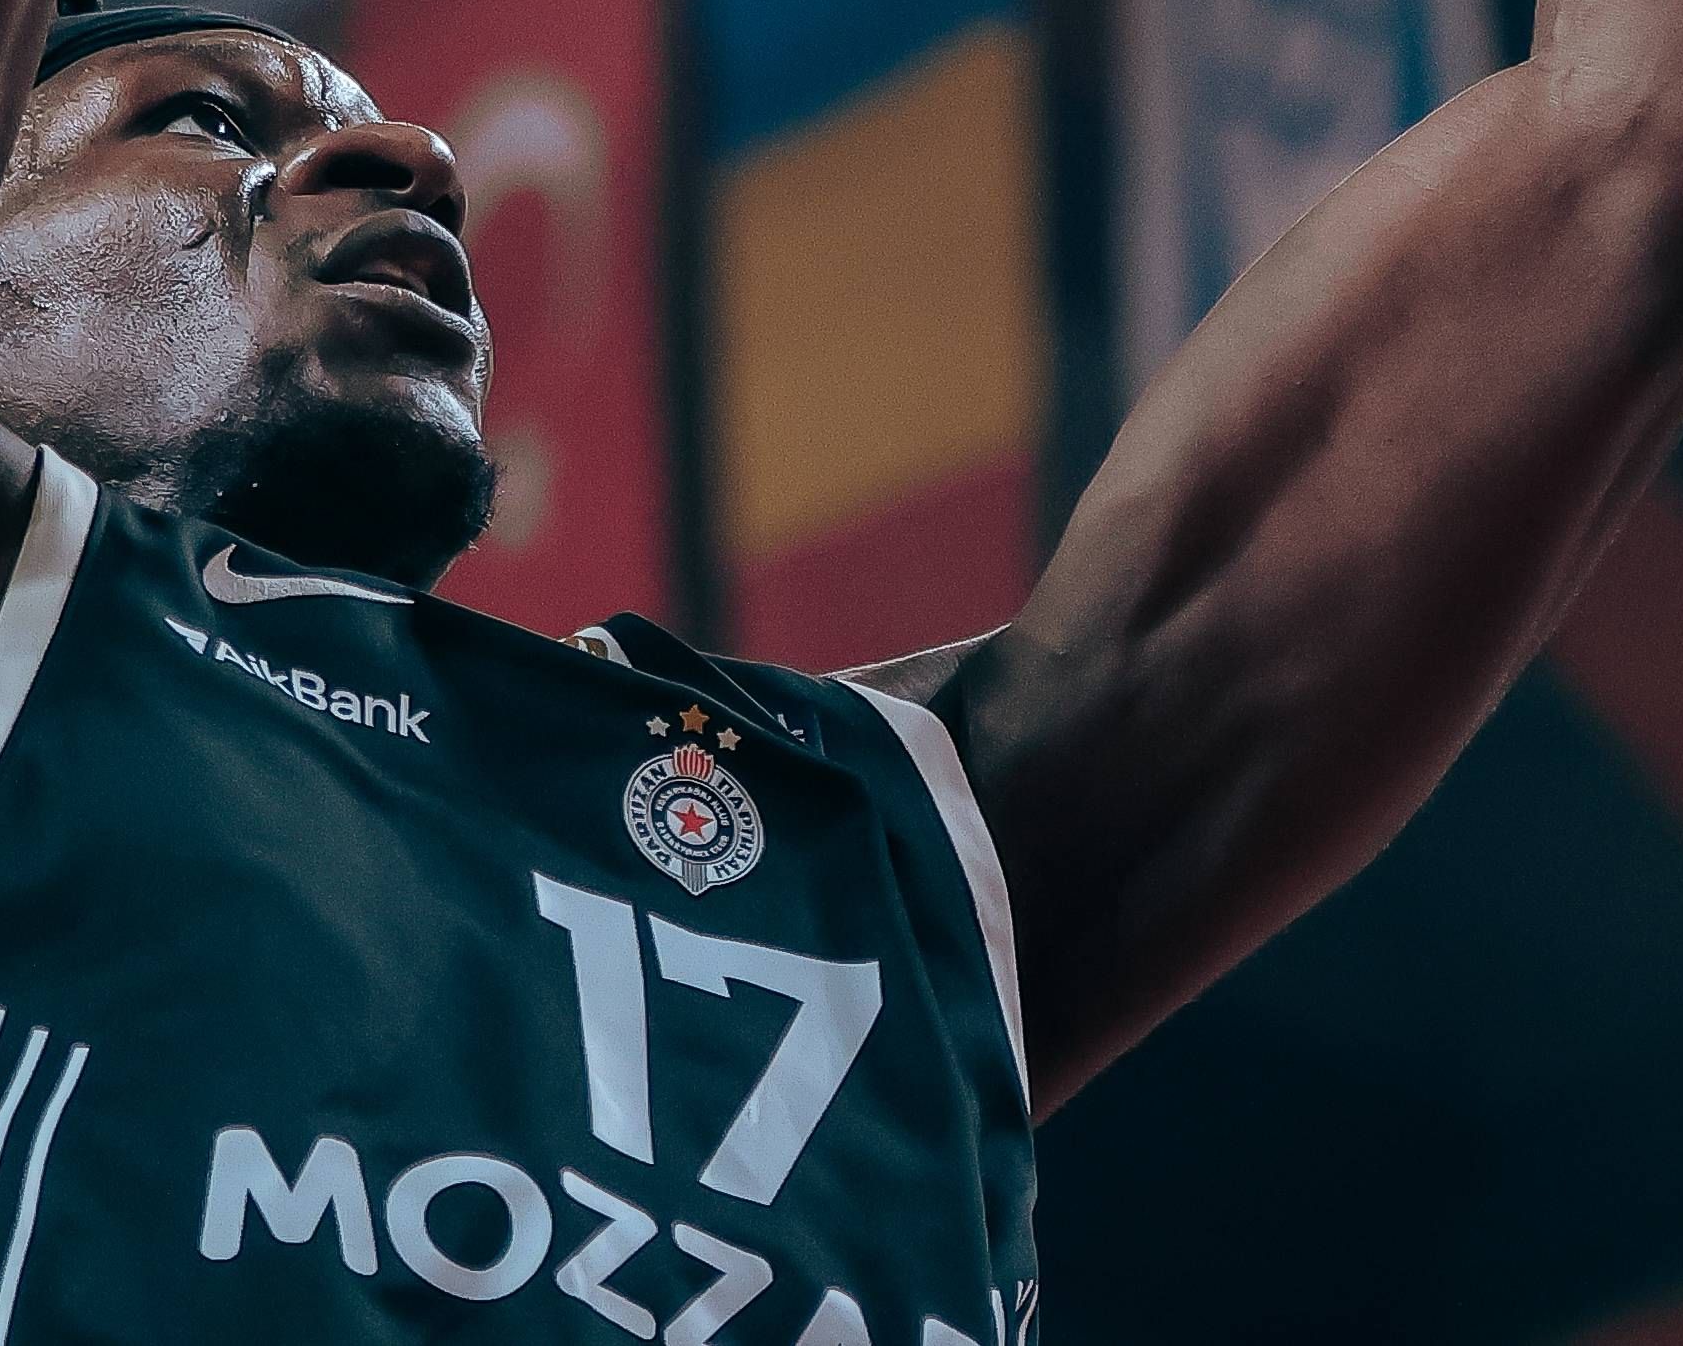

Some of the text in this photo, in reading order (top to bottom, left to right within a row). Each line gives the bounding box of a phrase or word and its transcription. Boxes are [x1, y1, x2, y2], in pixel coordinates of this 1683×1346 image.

[214, 639, 432, 744] AikBank
[630, 763, 668, 867] PARTIZAN
[712, 776, 754, 879] ПАРТИЗАН
[532, 869, 882, 1206] 17
[199, 1125, 982, 1346] MOZZ
